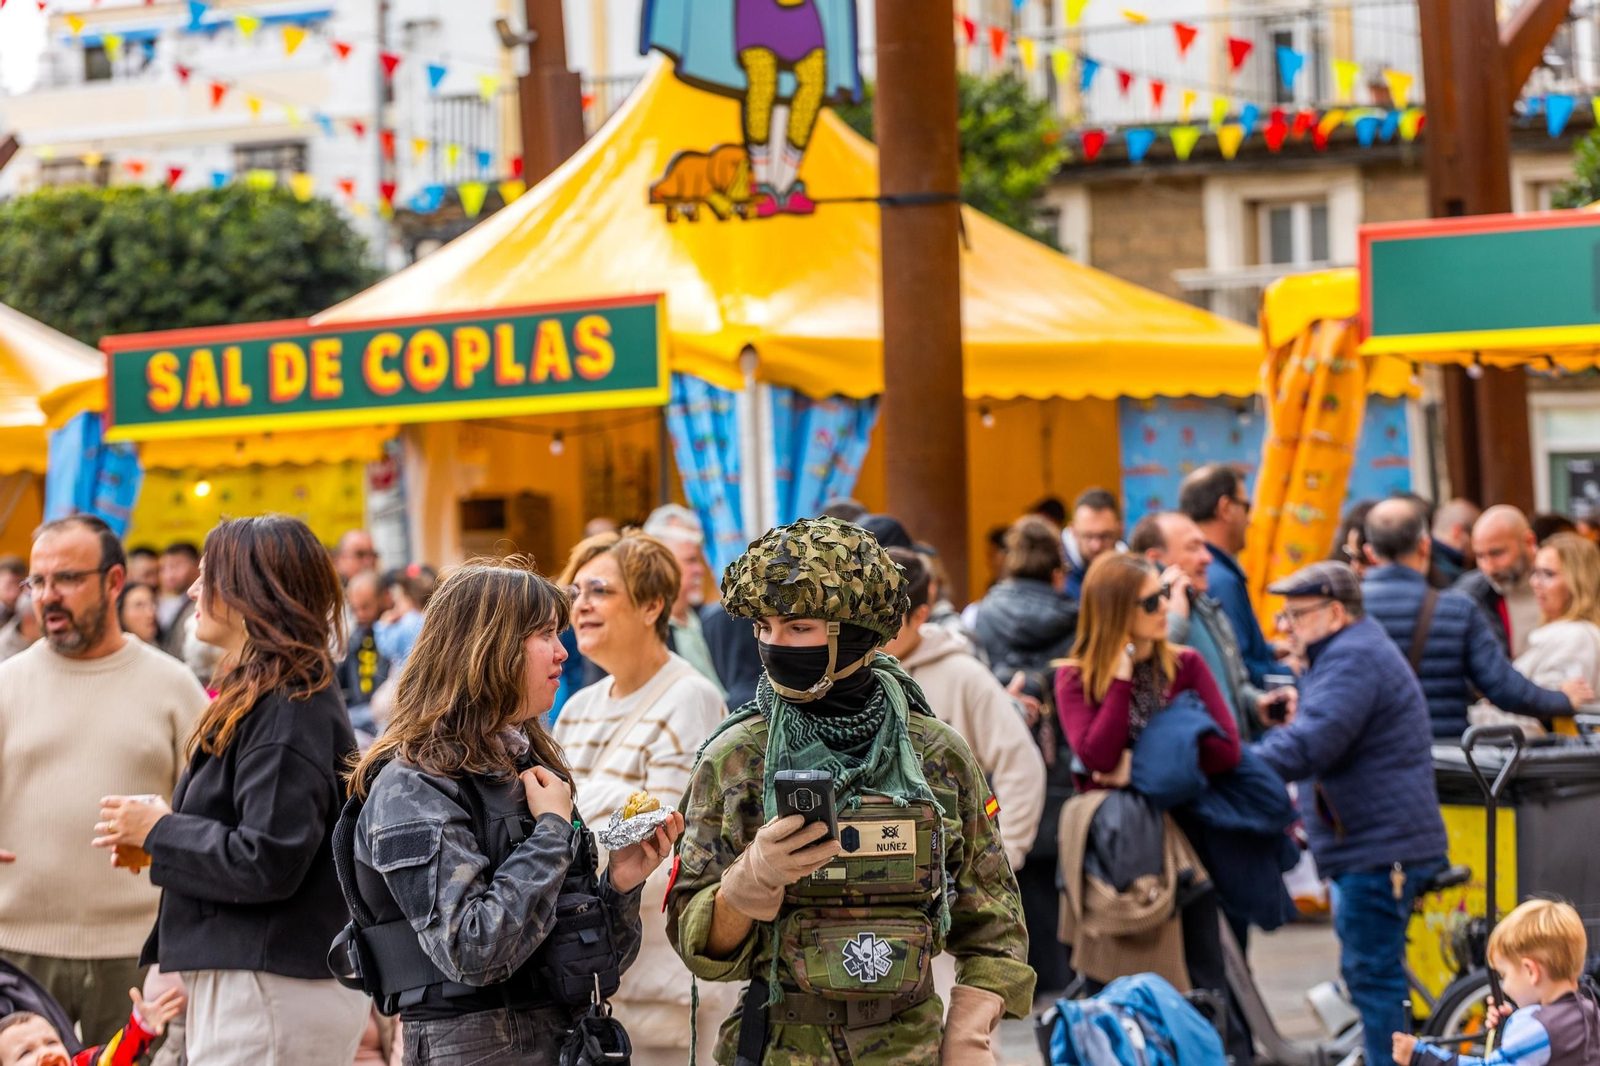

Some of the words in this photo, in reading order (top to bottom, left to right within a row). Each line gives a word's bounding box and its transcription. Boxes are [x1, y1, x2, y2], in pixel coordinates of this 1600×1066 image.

[147, 346, 252, 412] SAL
[268, 337, 343, 402] DE
[362, 314, 615, 395] COPLAS
[876, 841, 907, 851] NUÑEZ
